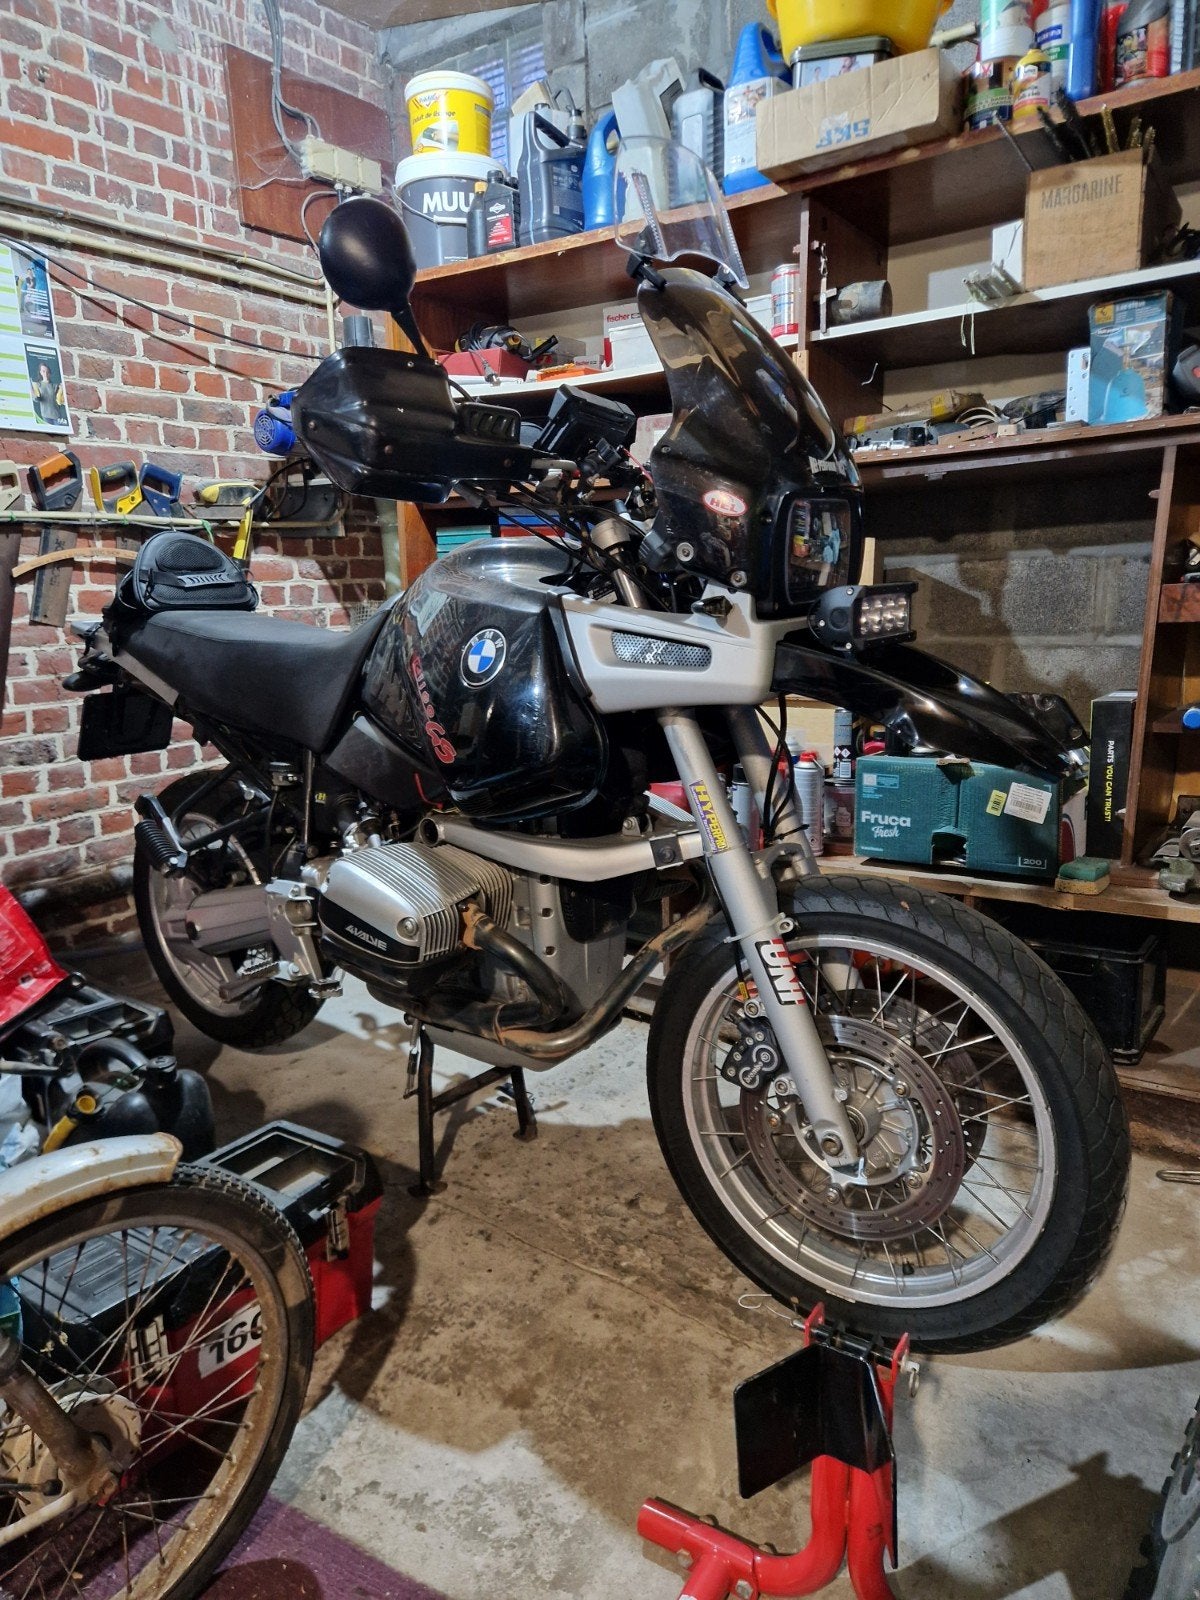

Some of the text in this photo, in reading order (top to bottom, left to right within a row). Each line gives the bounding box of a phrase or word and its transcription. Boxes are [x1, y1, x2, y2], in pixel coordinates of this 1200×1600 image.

[816, 118, 871, 149] SKF
[1041, 173, 1124, 210] MARGARINE
[606, 314, 630, 323] fischer
[470, 631, 504, 649] BMW
[1104, 740, 1115, 822] PARTS YOU CAN TRUST!
[694, 784, 728, 849] HYPERPRO
[861, 810, 911, 828] Fruca
[871, 825, 901, 839] Fresh
[1023, 858, 1043, 867] 200
[345, 924, 388, 952] 4VALVE
[744, 1061, 764, 1084] brembo
